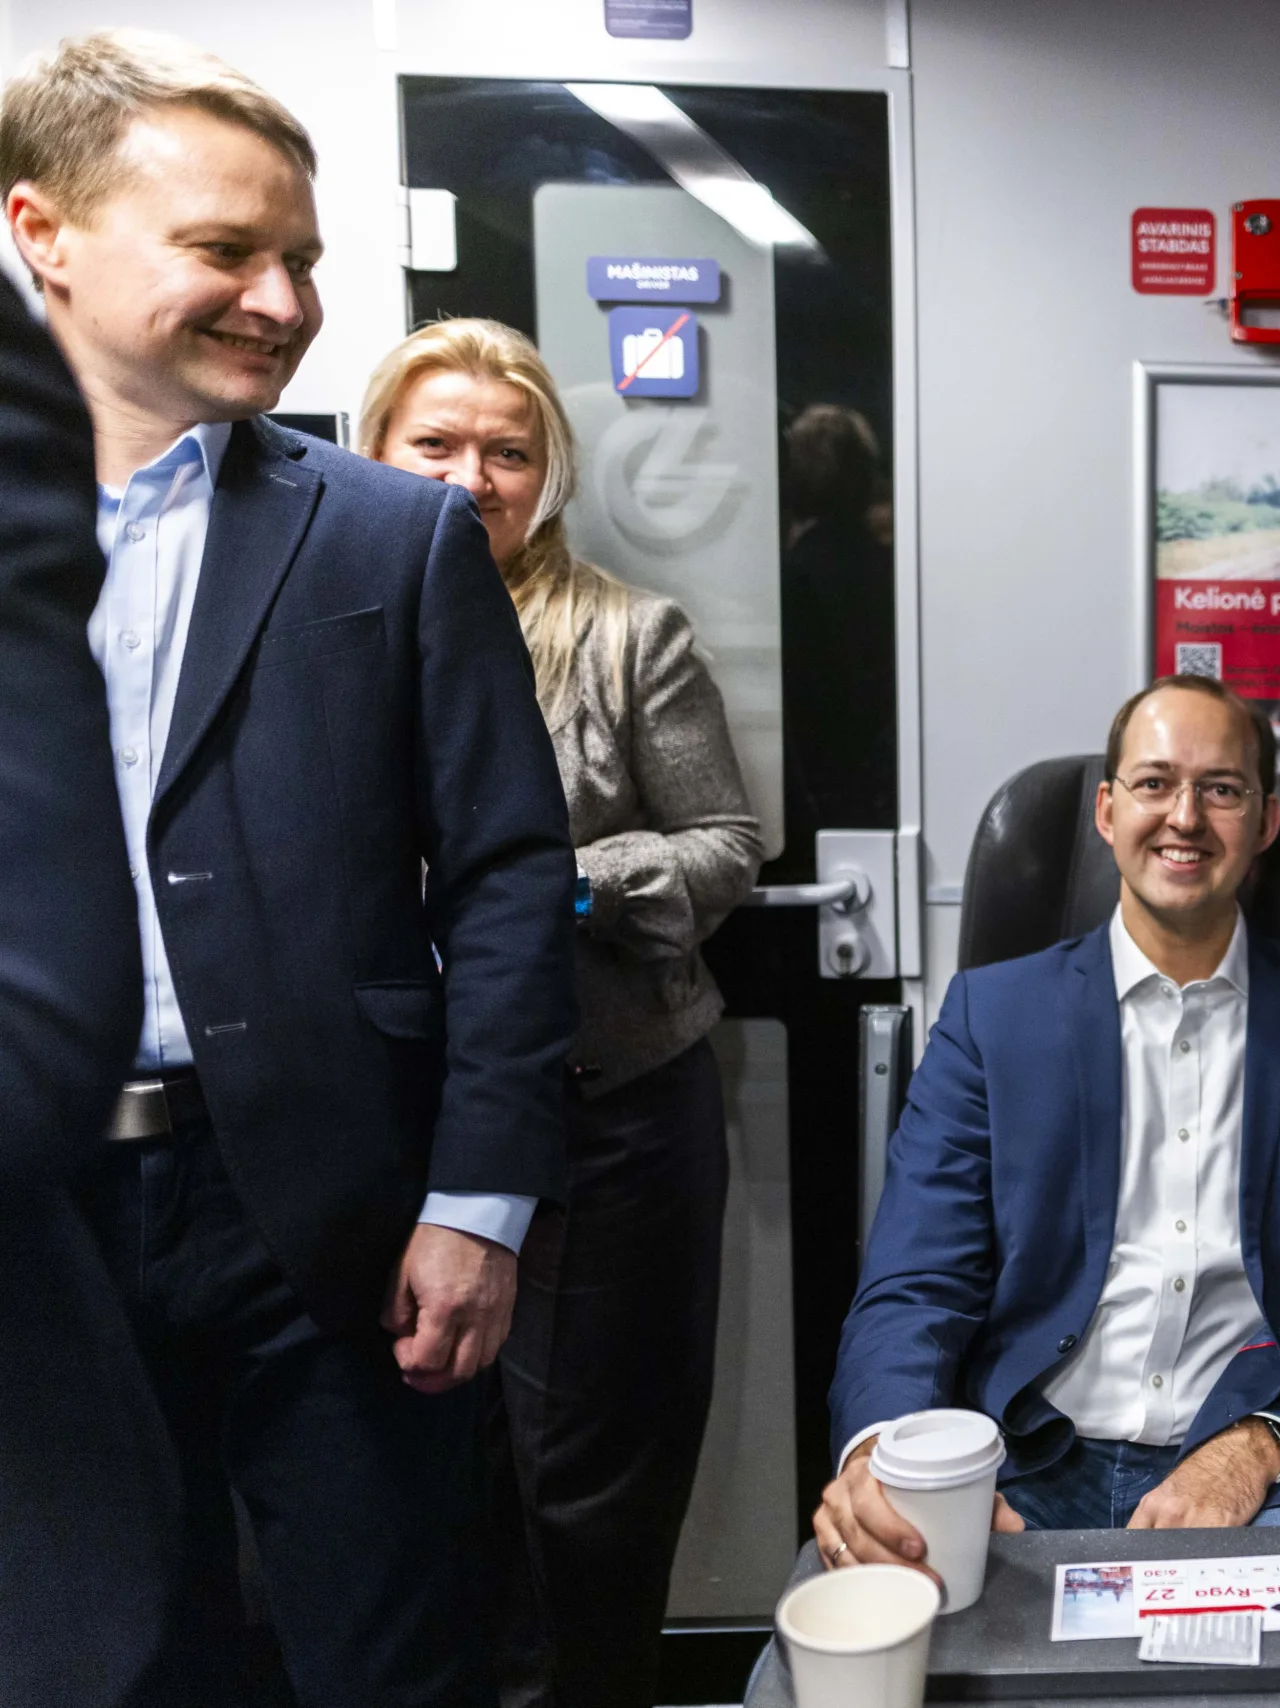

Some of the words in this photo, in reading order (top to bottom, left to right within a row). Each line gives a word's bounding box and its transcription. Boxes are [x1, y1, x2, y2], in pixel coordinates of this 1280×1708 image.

[1137, 222, 1211, 237] AVARINIS
[1138, 238, 1210, 254] STABDAS
[1174, 586, 1266, 611] Kelionė
[1144, 1568, 1177, 1578] 6:30
[1145, 1588, 1176, 1601] 27
